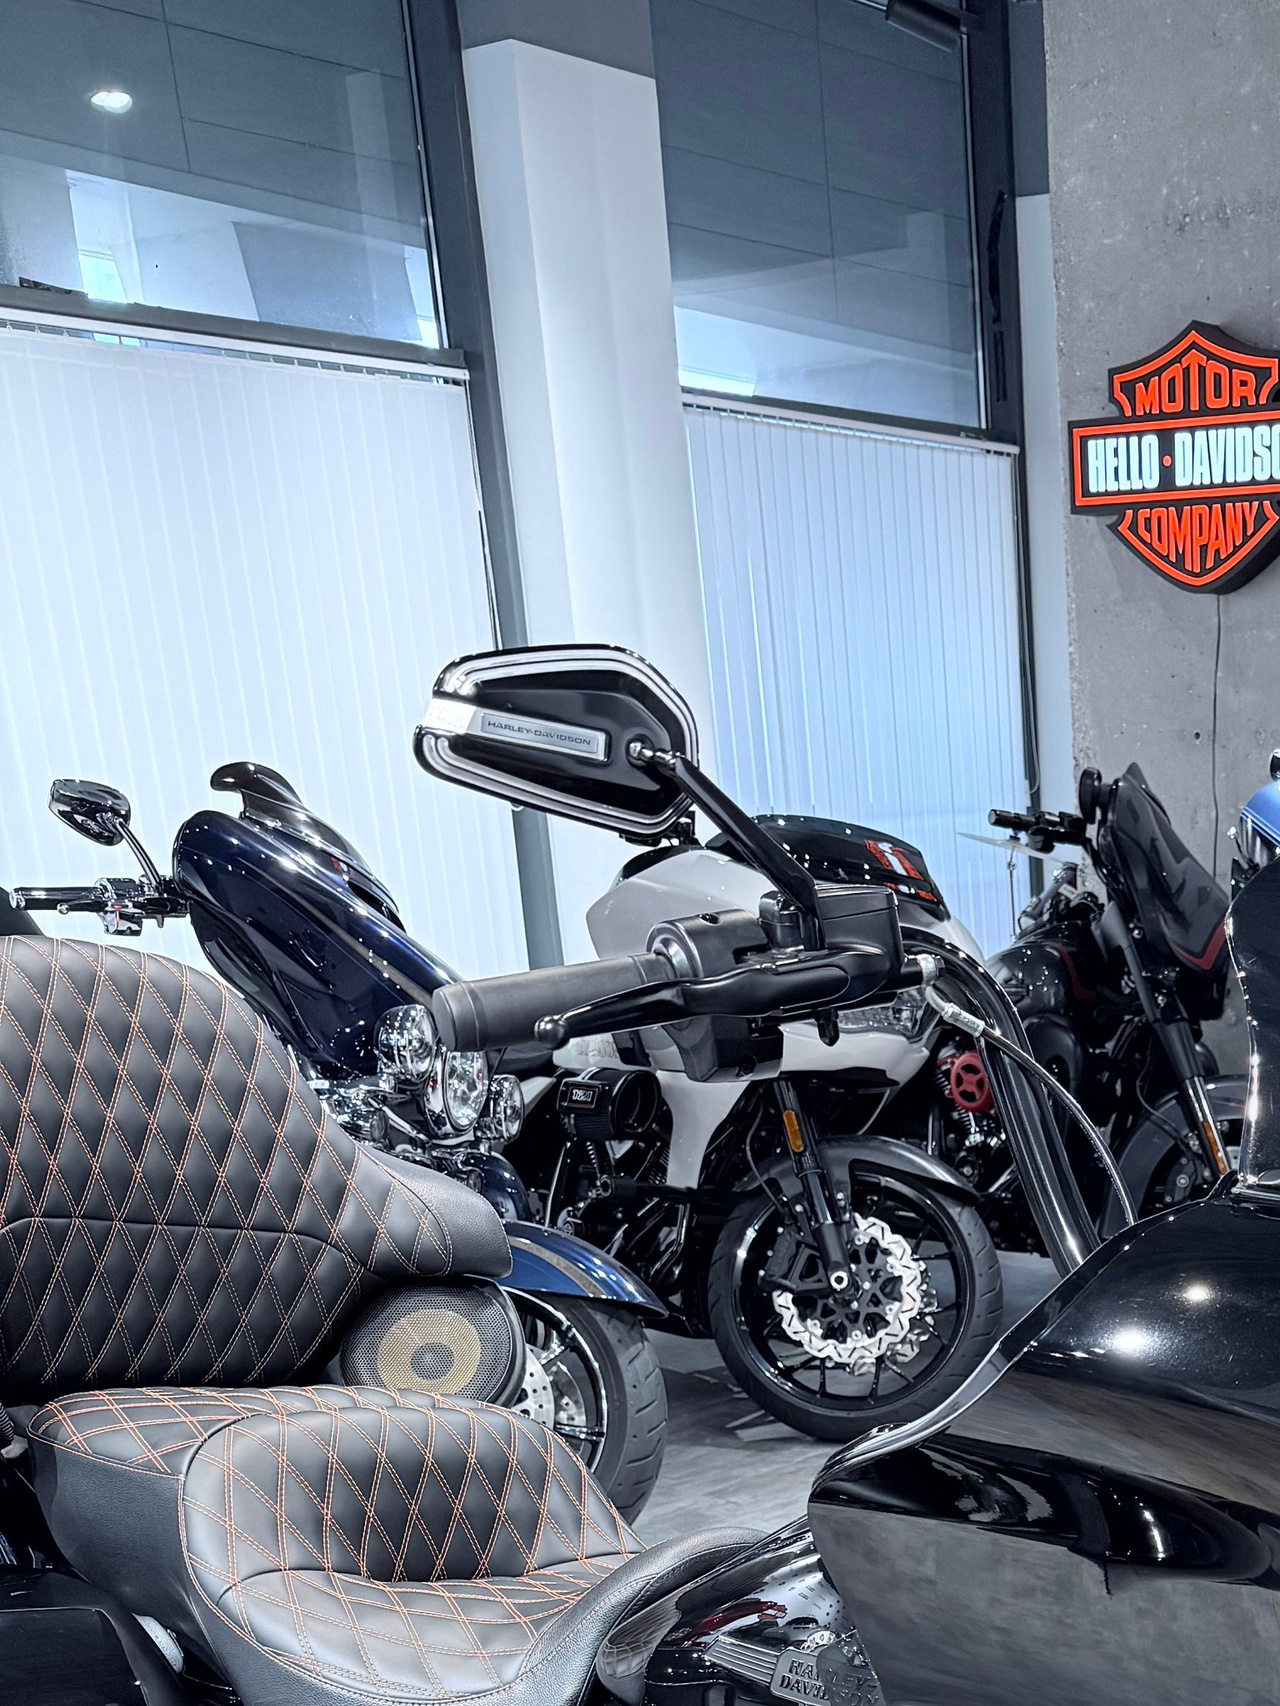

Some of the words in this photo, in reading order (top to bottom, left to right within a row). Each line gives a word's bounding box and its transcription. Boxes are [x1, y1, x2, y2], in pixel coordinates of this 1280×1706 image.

[1135, 349, 1257, 416] MOTOR
[1087, 434, 1161, 493] HELLO
[1137, 501, 1259, 574] COMPANY
[487, 720, 592, 746] HARLEY-DAVIDSON
